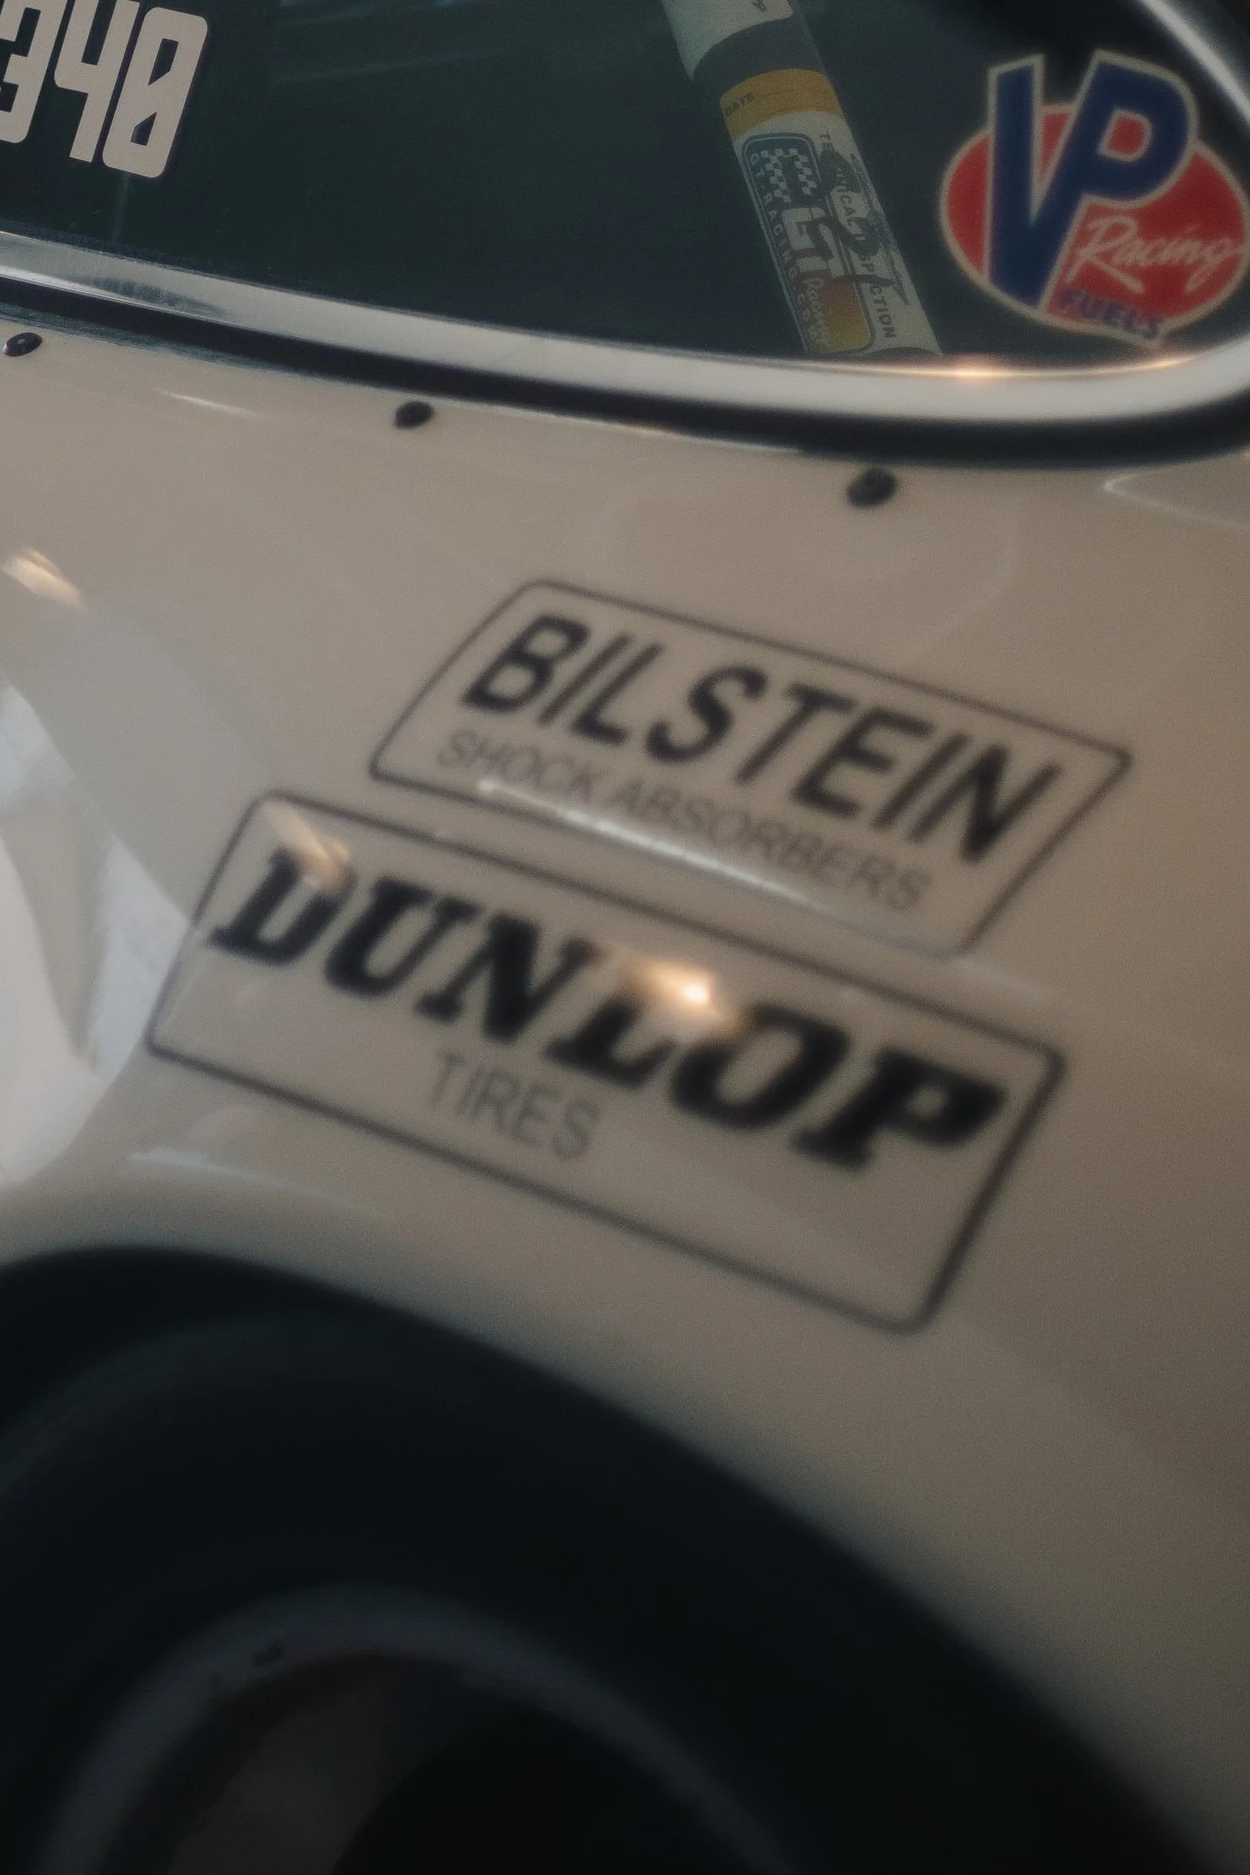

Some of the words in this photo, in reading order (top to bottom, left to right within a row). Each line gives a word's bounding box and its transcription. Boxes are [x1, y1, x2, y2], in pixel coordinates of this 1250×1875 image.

[817, 131, 864, 232] TEICAL
[851, 230, 898, 340] ISPCTION
[986, 47, 1198, 311] VP
[1065, 215, 1245, 293] Racing
[435, 727, 596, 805] SHOCK
[611, 777, 934, 912] ABSORBERS
[460, 613, 1063, 863] BILSTEIN
[210, 847, 1008, 1173] DUNLOP
[430, 1051, 600, 1161] TIRES
